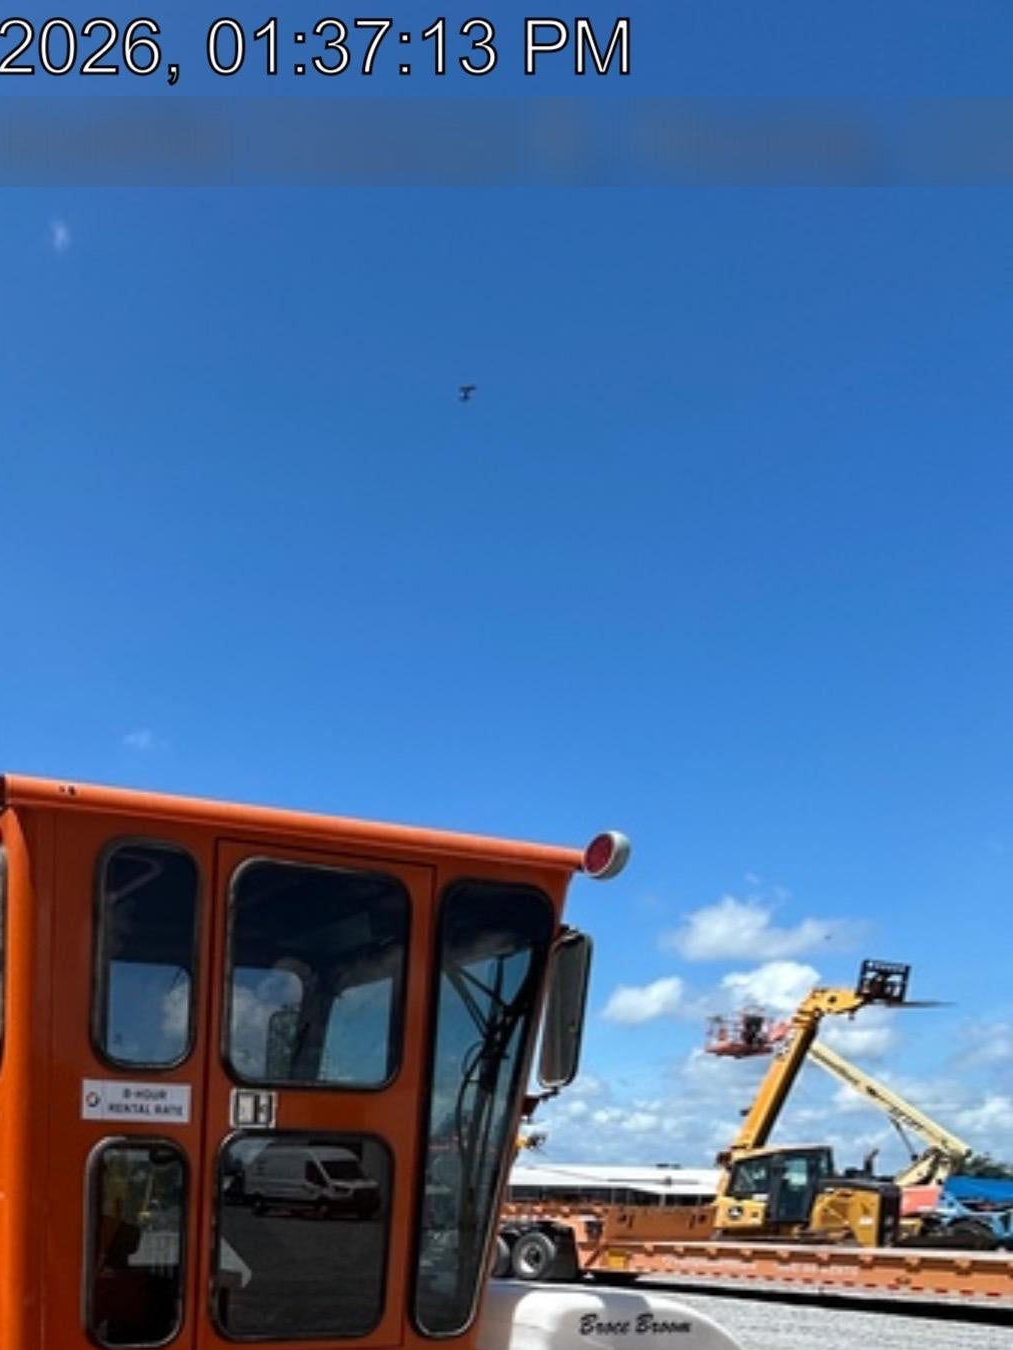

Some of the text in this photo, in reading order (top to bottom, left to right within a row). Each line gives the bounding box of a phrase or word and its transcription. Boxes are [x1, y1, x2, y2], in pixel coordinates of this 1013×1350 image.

[108, 1103, 183, 1116] RENTAL RATE
[579, 1313, 692, 1336] Broce Broom
